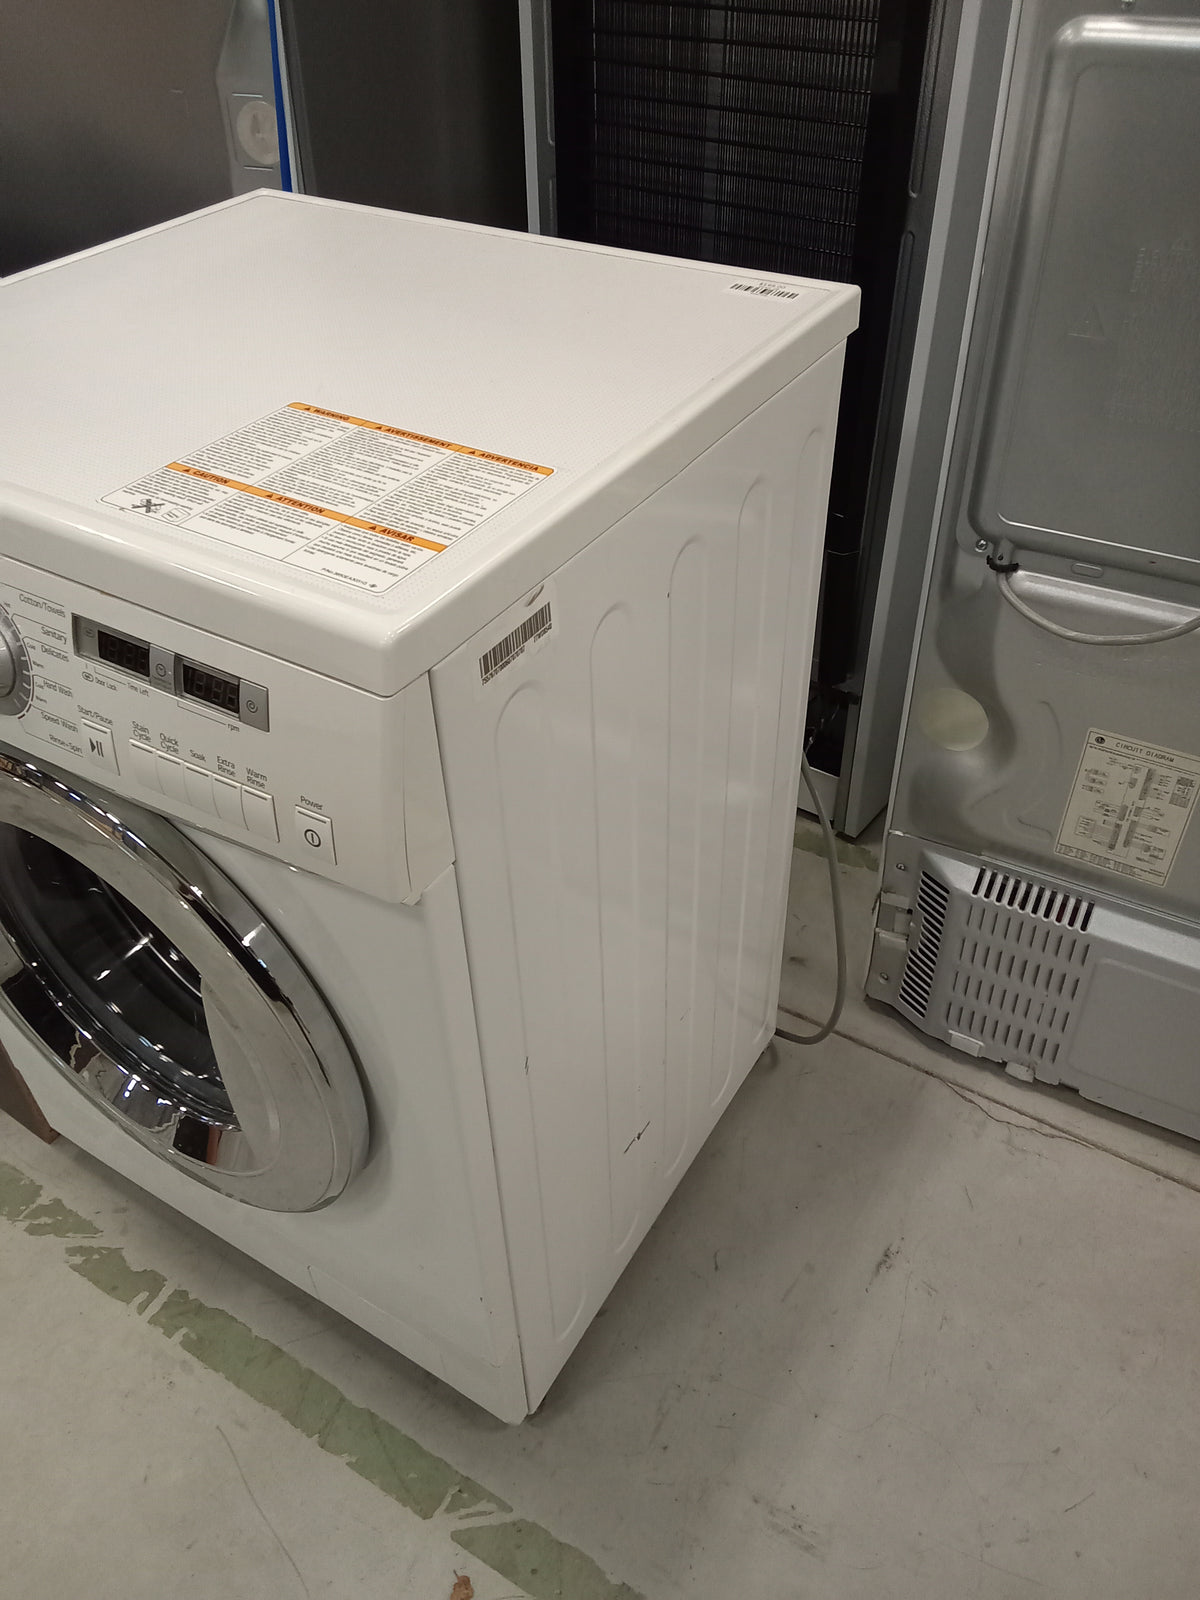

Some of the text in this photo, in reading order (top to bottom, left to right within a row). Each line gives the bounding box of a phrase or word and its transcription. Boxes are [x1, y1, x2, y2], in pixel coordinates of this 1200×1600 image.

[385, 427, 451, 448] AVERTISSEMENT
[479, 452, 538, 472] ADVERTENCIA
[193, 471, 228, 484] CAUTION
[277, 495, 325, 514] ATTENTION
[381, 527, 414, 542] AVISAR
[19, 593, 66, 618] Cotton/Towels
[41, 626, 67, 645] Sanitary
[41, 645, 69, 662] Delicates
[77, 705, 113, 725] Start/Pause
[132, 720, 149, 735] Stain
[228, 723, 240, 732] rpm
[133, 729, 152, 743] Cycle
[160, 732, 179, 747] Quick
[160, 741, 180, 755] Cycle
[190, 749, 206, 763] Soak
[217, 755, 235, 770] Extra
[217, 764, 236, 778] Rinse
[246, 767, 268, 782] Warm
[246, 775, 266, 790] Rinse
[300, 795, 323, 811] Power
